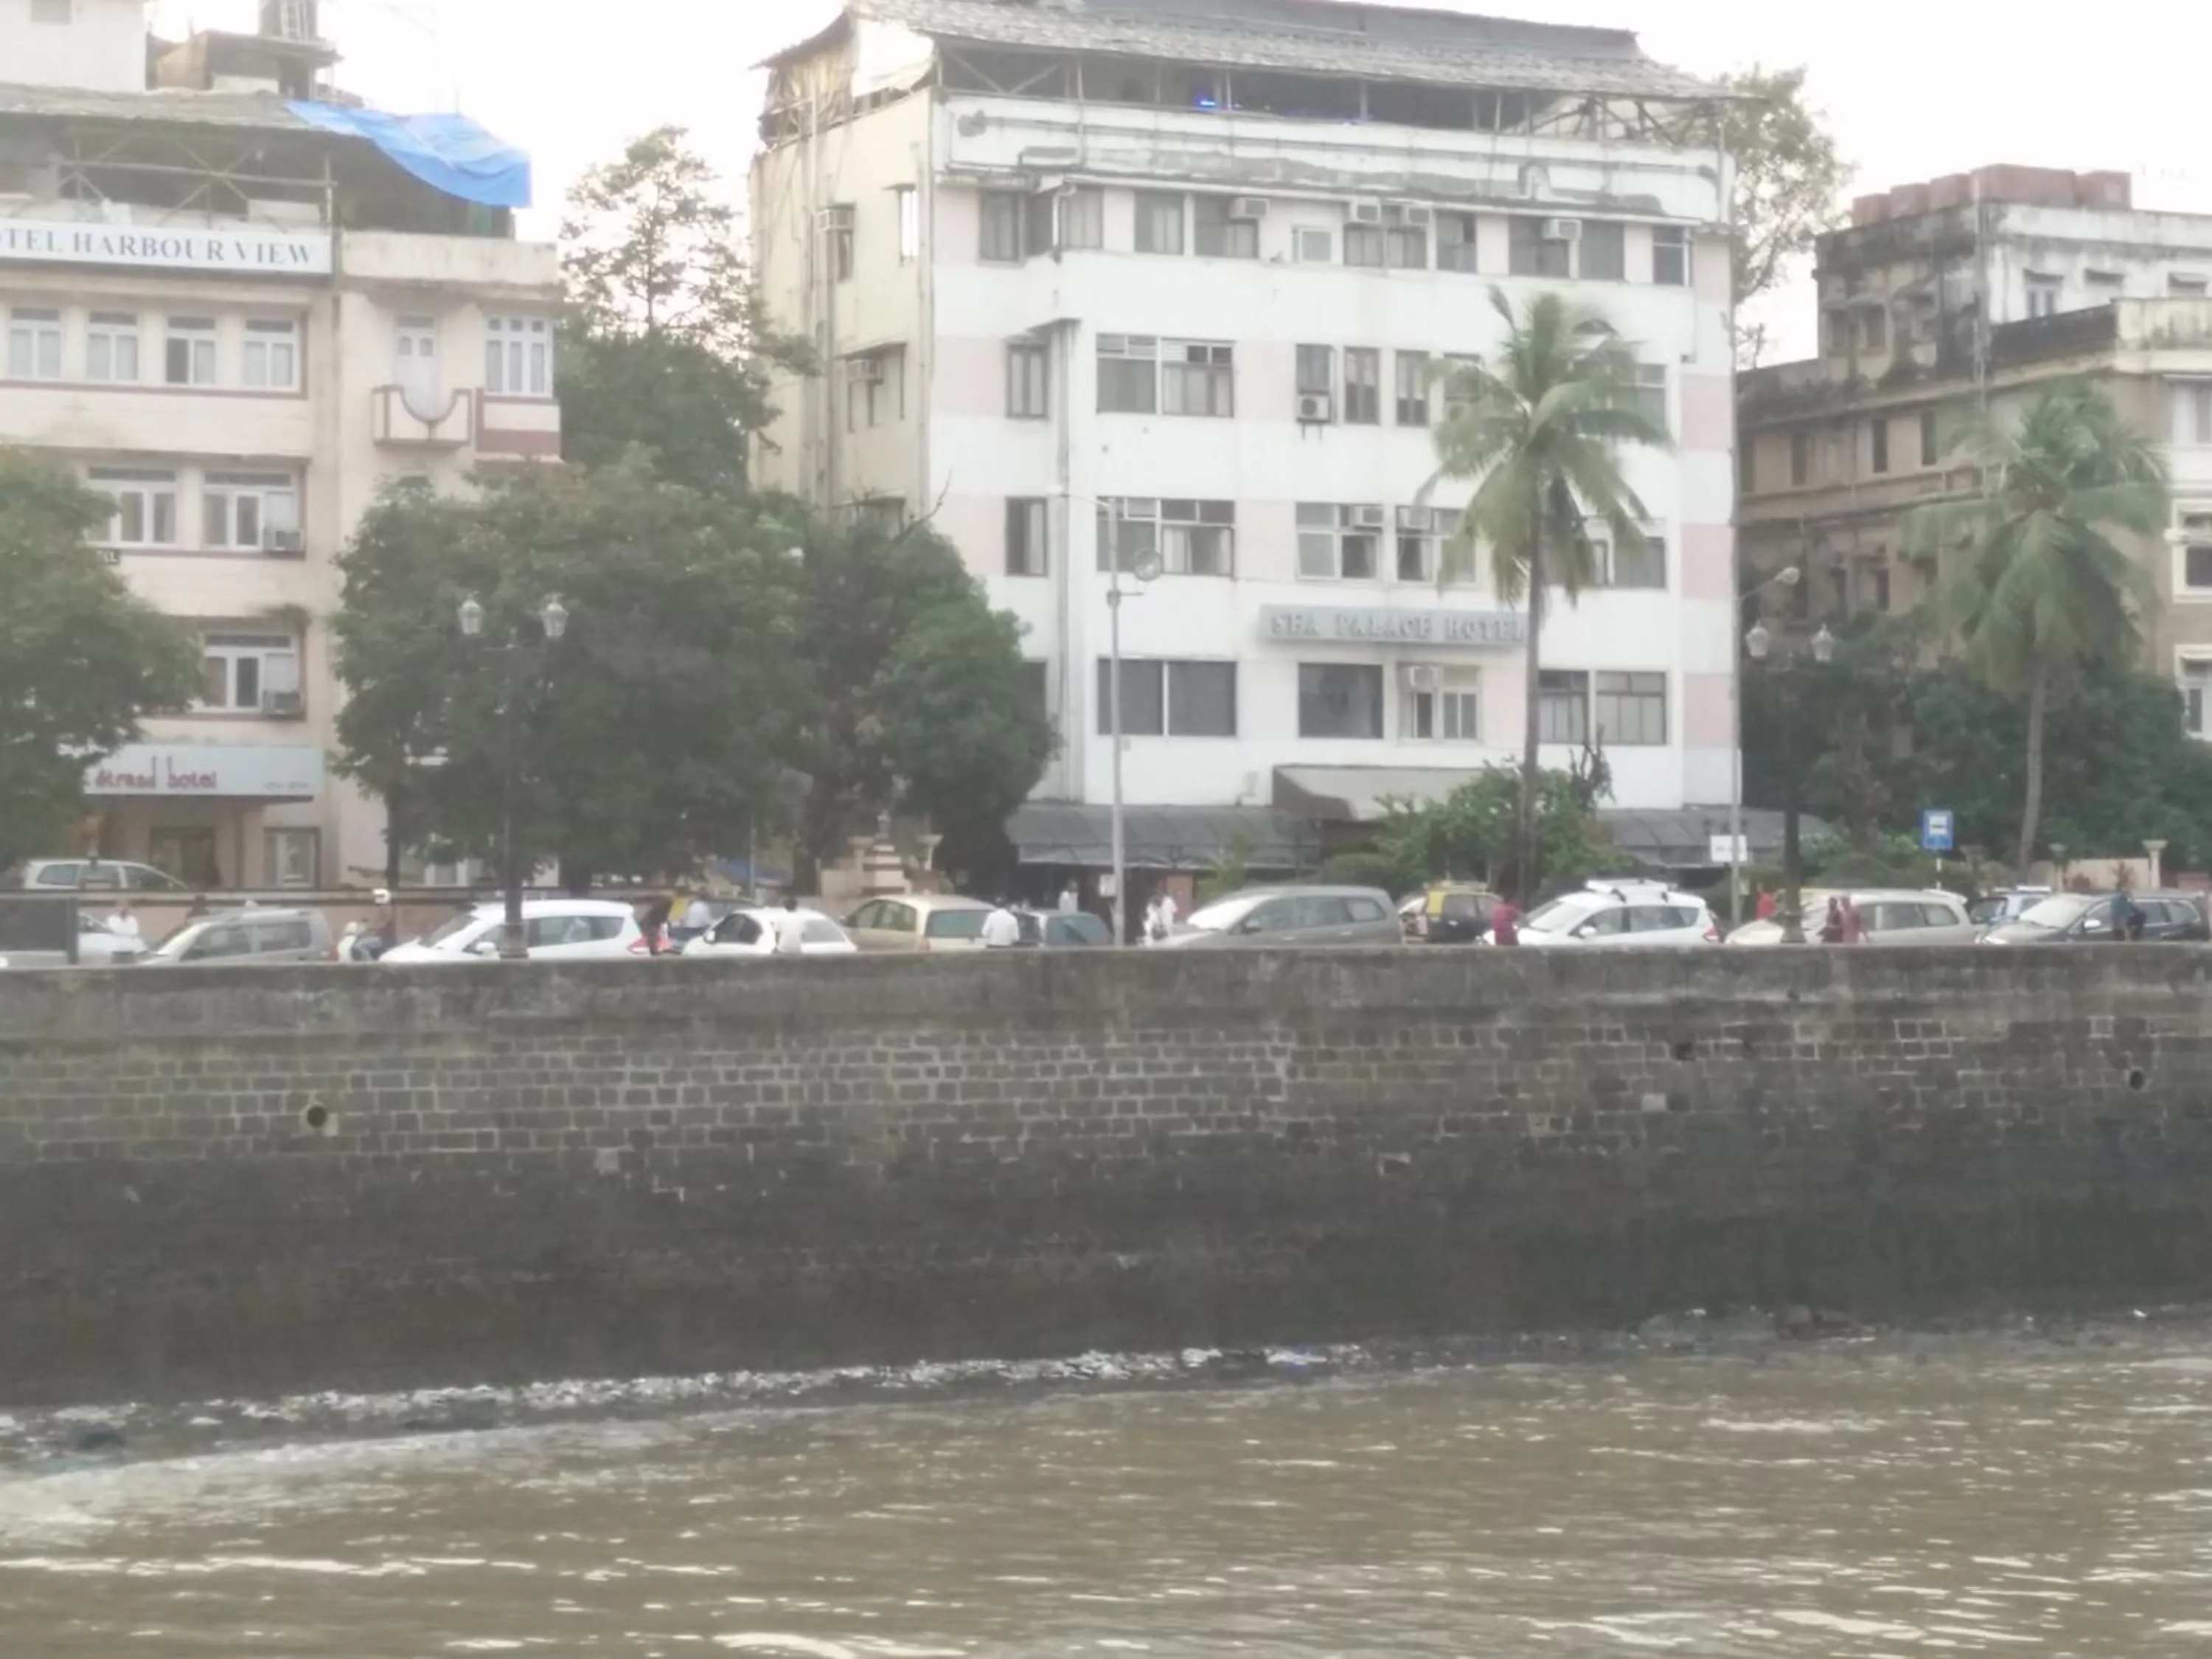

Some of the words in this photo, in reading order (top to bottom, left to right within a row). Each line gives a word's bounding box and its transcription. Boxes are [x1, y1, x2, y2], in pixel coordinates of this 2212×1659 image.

[0, 227, 63, 252] TEL
[74, 232, 224, 261] HARBOUR
[232, 242, 316, 265] VIEW
